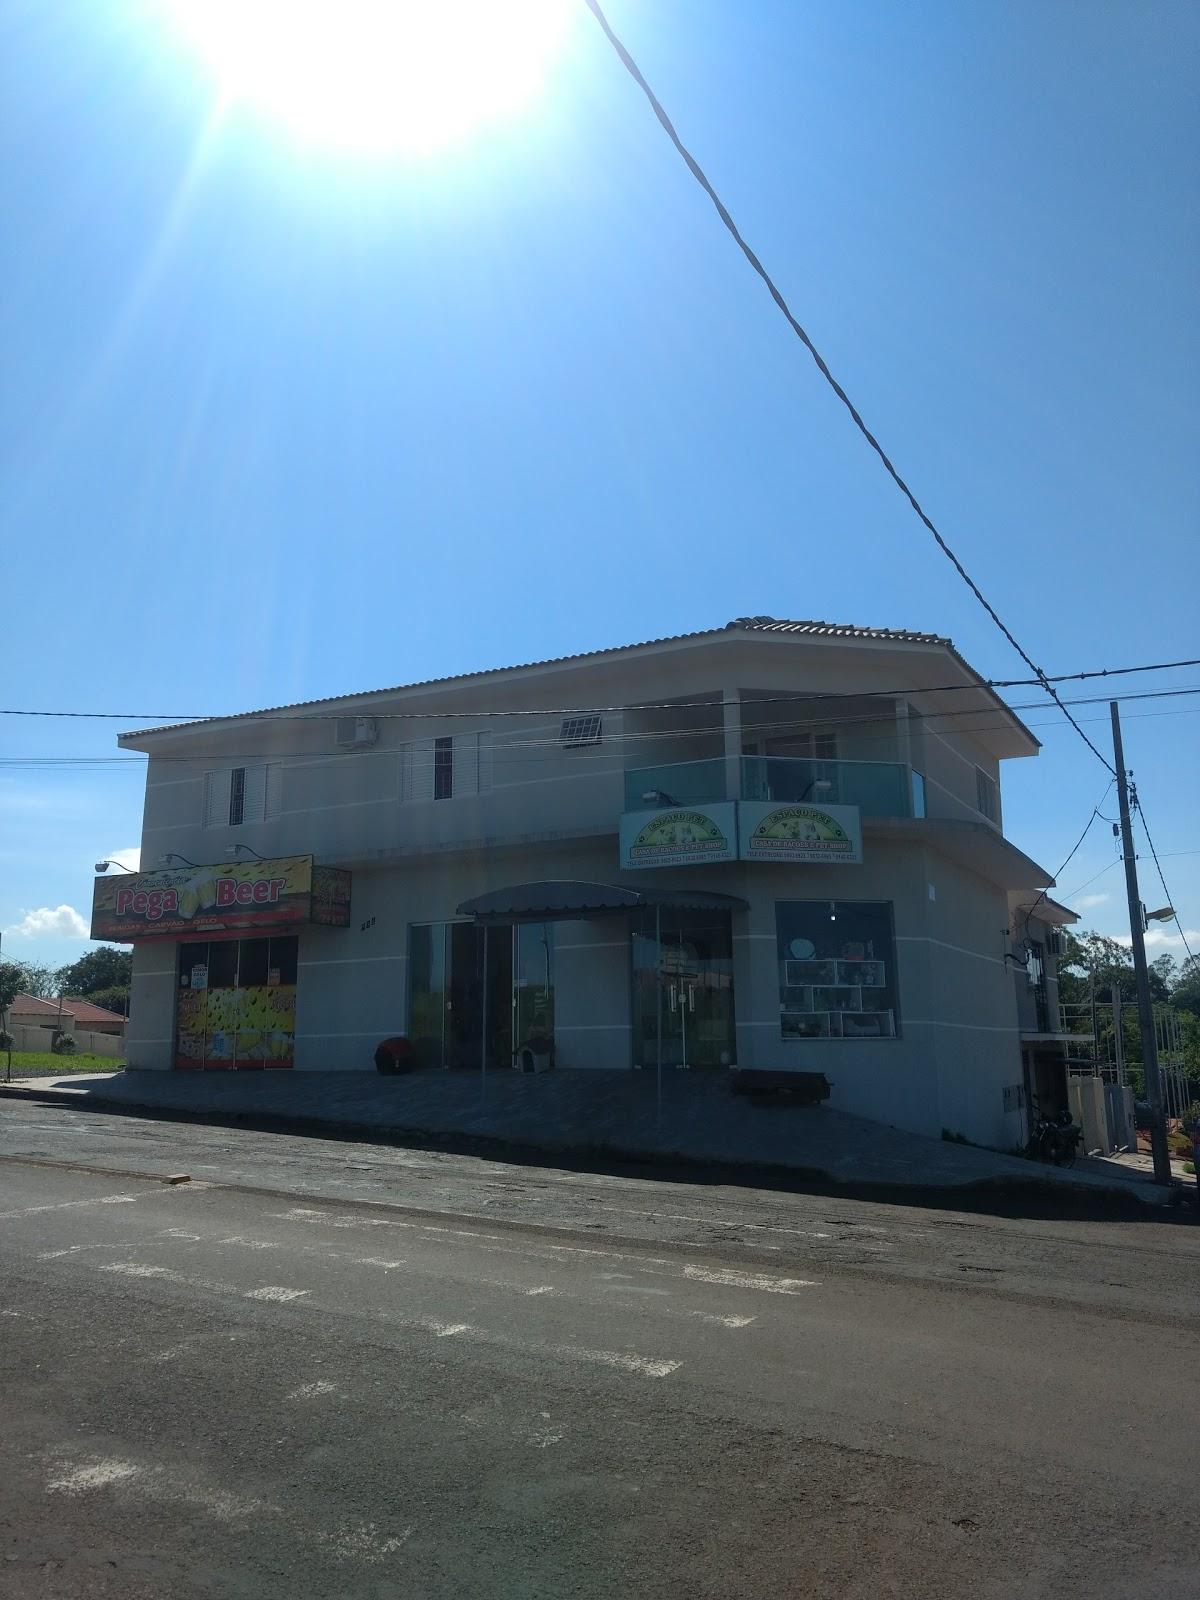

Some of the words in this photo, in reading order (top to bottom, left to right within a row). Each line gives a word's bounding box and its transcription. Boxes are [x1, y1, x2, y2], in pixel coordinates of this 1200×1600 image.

[648, 813, 685, 831] ESPAÇO
[687, 813, 705, 824] PET
[768, 808, 809, 823] ESPAÇO
[810, 809, 831, 824] PET
[703, 841, 722, 849] SHOP
[116, 888, 178, 920] Pega
[215, 877, 286, 907] Beer
